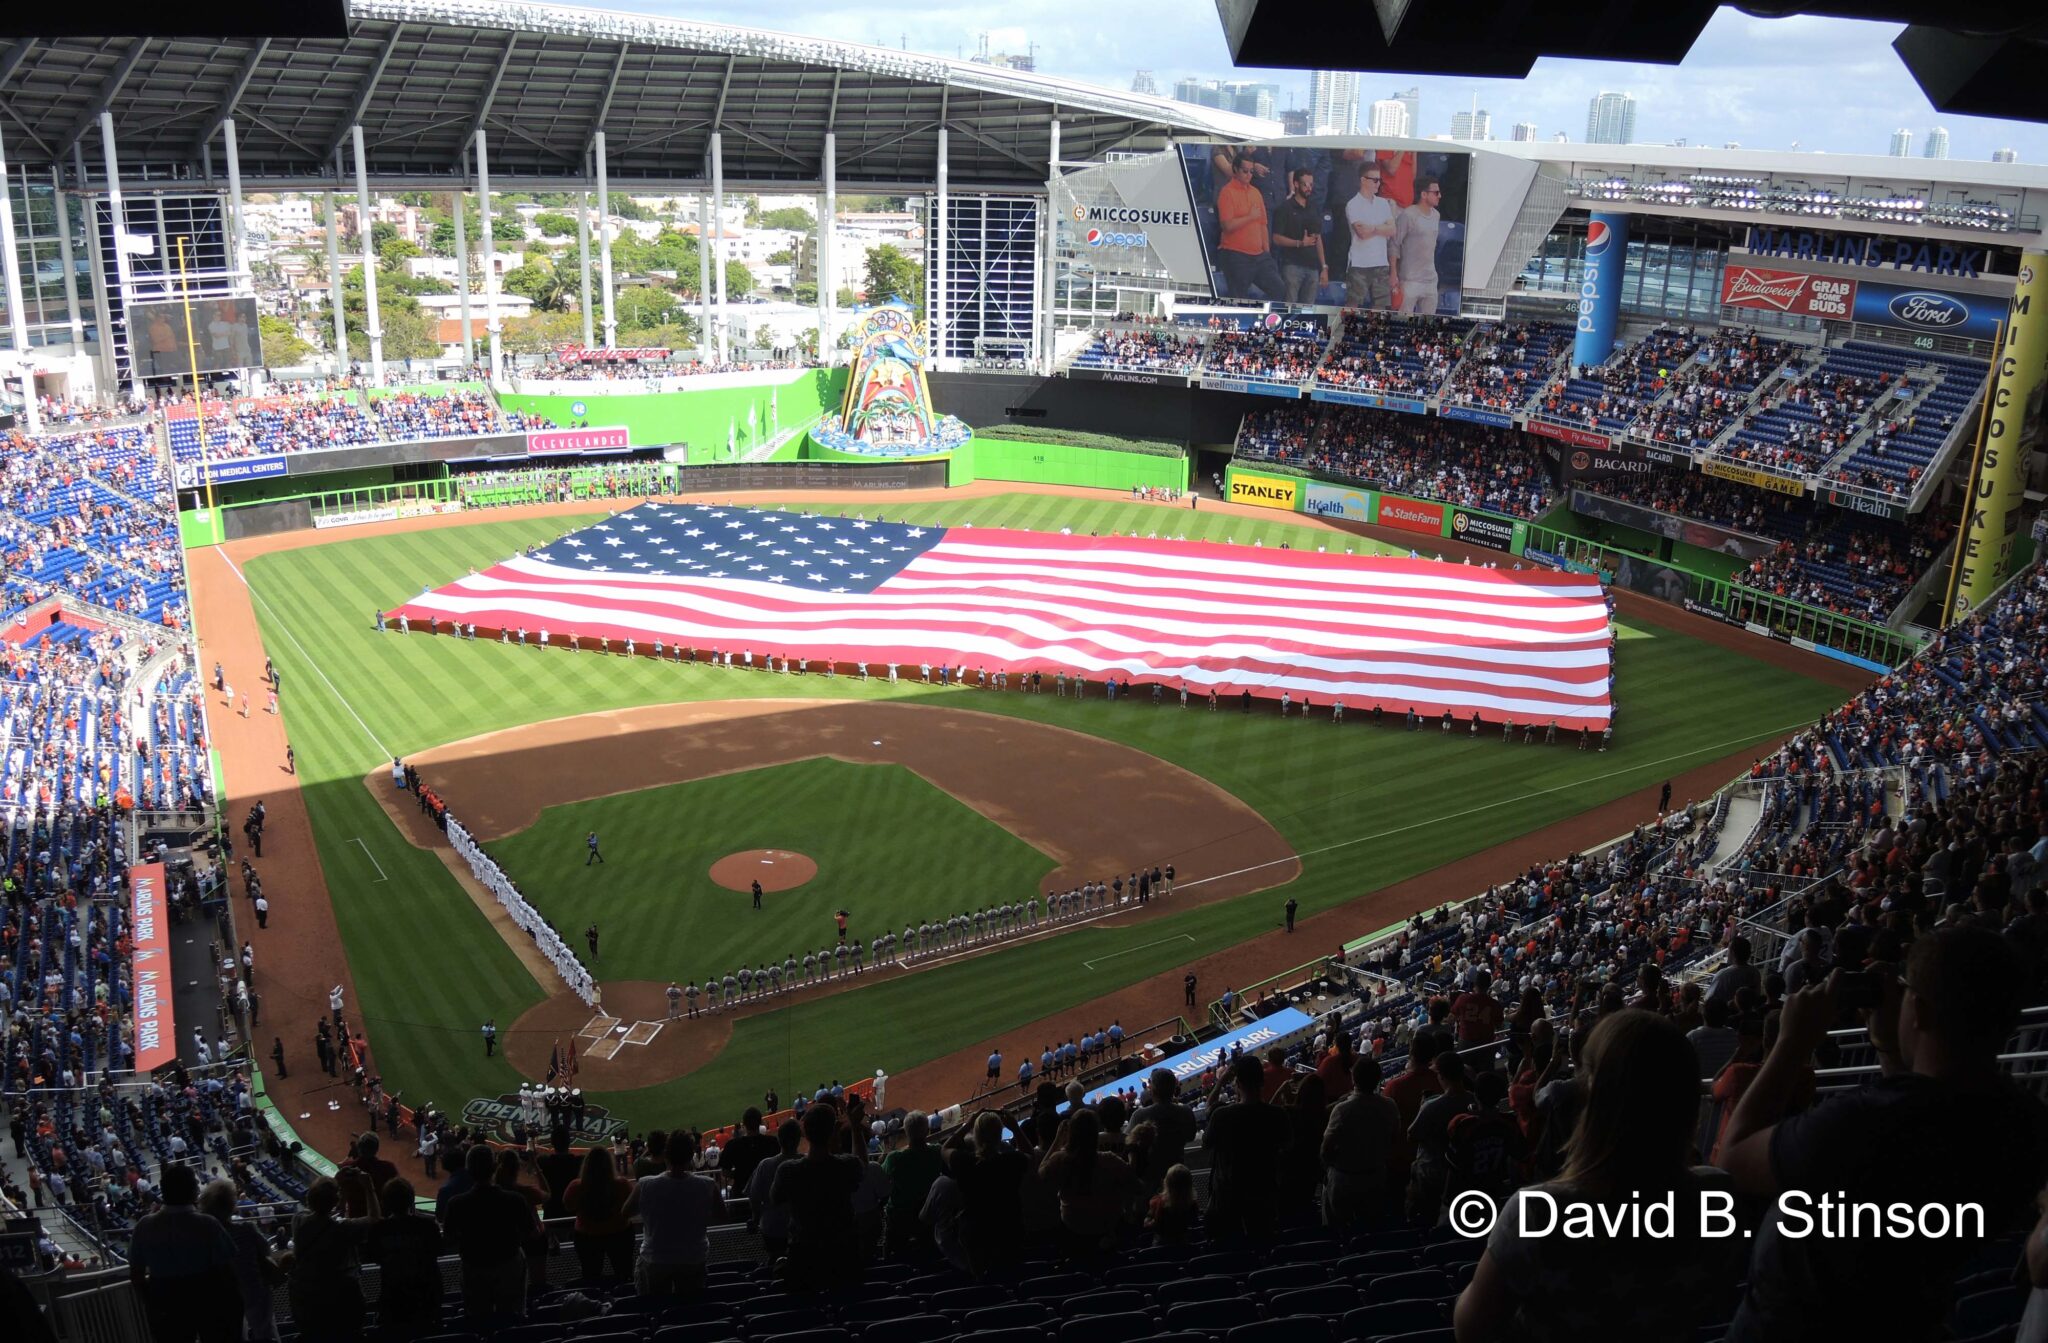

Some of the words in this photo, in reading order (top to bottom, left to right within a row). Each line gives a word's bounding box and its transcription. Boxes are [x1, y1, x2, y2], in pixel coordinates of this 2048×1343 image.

[1089, 207, 1189, 225] MICCOSUKEE
[1104, 232, 1147, 249] pepsi
[1750, 229, 1882, 268] MARLINS
[1894, 242, 1979, 278] PARK
[1731, 276, 1803, 298] Budweiser
[1811, 280, 1850, 296] GRAB
[1577, 262, 1600, 333] pepsi
[1816, 292, 1842, 302] SOME
[1809, 299, 1846, 315] BUDS
[1902, 295, 1954, 326] Ford
[1914, 336, 1934, 349] 448
[557, 342, 670, 363] Budweiser
[1102, 371, 1158, 385] MARLINS.COM
[1206, 379, 1245, 393] wellmax
[1452, 408, 1471, 420] pepsi
[1475, 413, 1487, 422] LIVE
[1487, 415, 1496, 423] FOR
[1497, 416, 1512, 426] NOW
[1530, 422, 1538, 432] Fly
[531, 434, 624, 450] CLEVELANDER
[1571, 431, 1579, 441] Fly
[1581, 434, 1601, 445] Avianca
[1960, 294, 2031, 587] MICCOSUKEE
[1646, 450, 1673, 464] BACARDÍ
[219, 466, 251, 477] MEDICAL
[252, 461, 284, 473] CENTERS
[1594, 458, 1652, 473] BACARDÍ
[1714, 464, 1756, 479] MICCOSUKEE
[854, 479, 906, 489] MARLINS.COM
[1232, 483, 1294, 501] STANLEY
[1765, 480, 1800, 496] GAME!
[1469, 519, 1512, 535] MICCOSUKEE
[1702, 606, 1724, 618] NETWORK
[135, 878, 156, 916] MARLINS
[136, 917, 154, 941] PARK
[137, 971, 160, 1019] MARLINS
[140, 1022, 159, 1051] PARK
[1227, 1027, 1278, 1052] PARK
